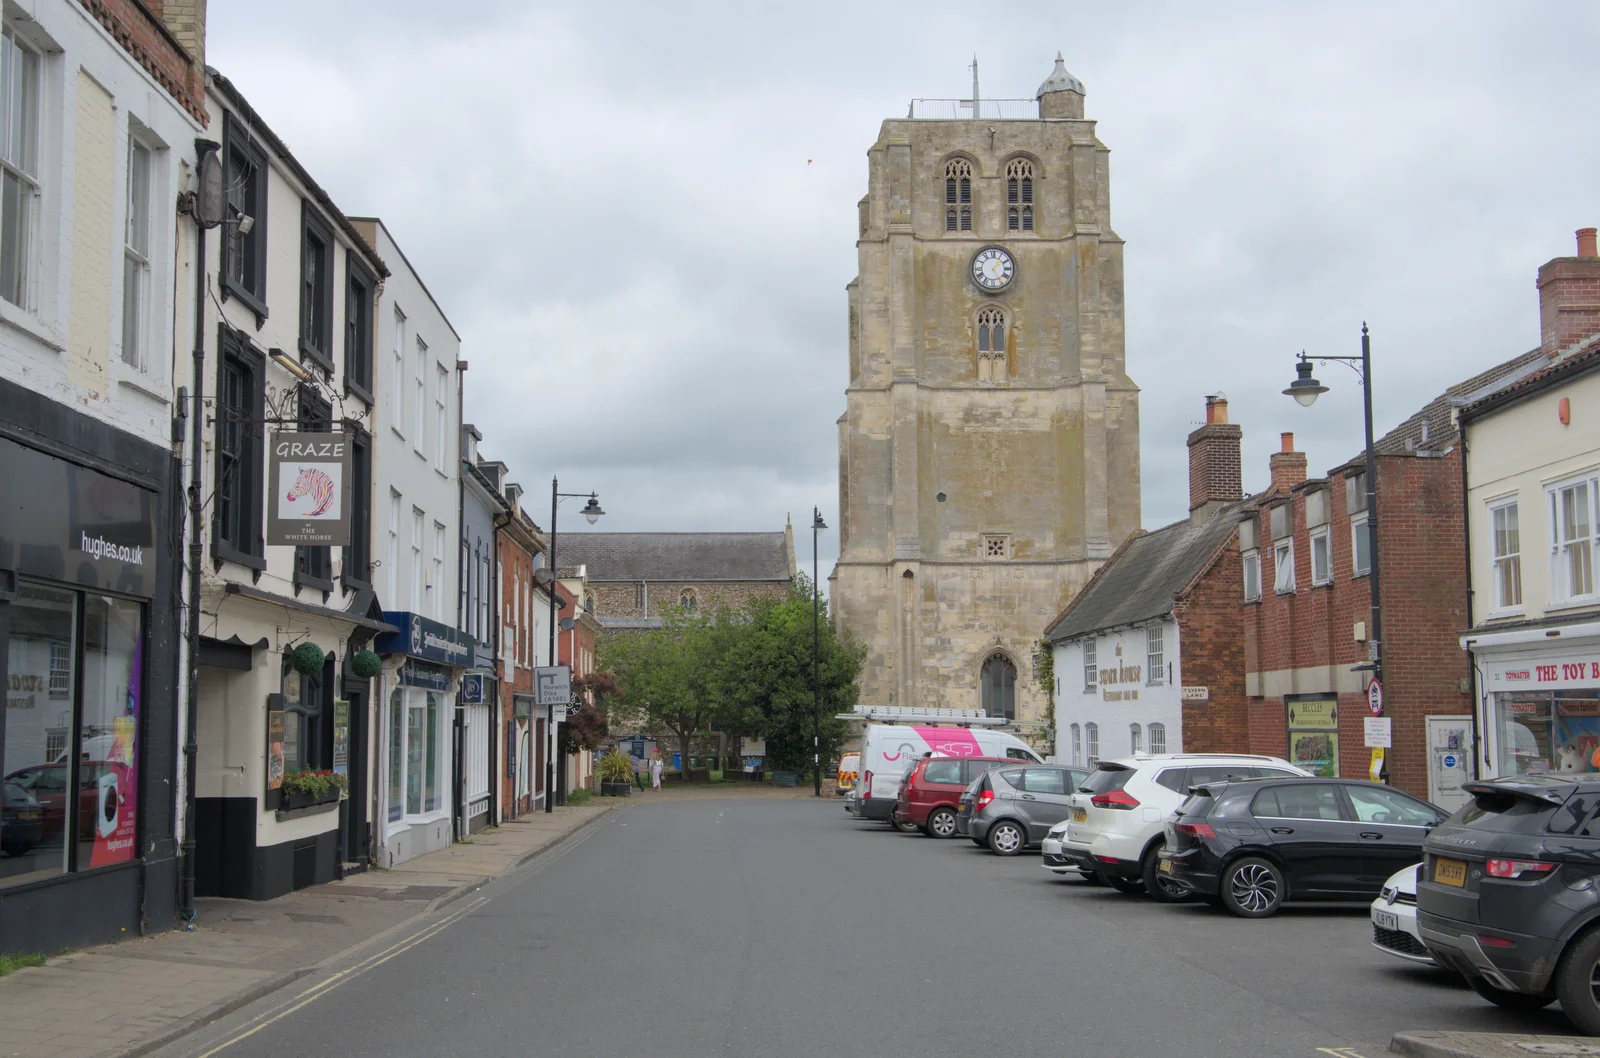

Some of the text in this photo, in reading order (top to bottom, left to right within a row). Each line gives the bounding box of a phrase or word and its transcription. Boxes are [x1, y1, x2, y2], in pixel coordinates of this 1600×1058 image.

[276, 442, 345, 458] GRAZE
[82, 530, 142, 565] hughes.co.uk
[1120, 659, 1141, 683] house
[1505, 671, 1531, 680] TOYMASTER
[1536, 665, 1558, 682] THE
[1562, 663, 1586, 680] TOY
[1302, 702, 1322, 712] BECCLES
[1512, 704, 1536, 712] TOYMASTER
[1450, 836, 1476, 846] ROVER
